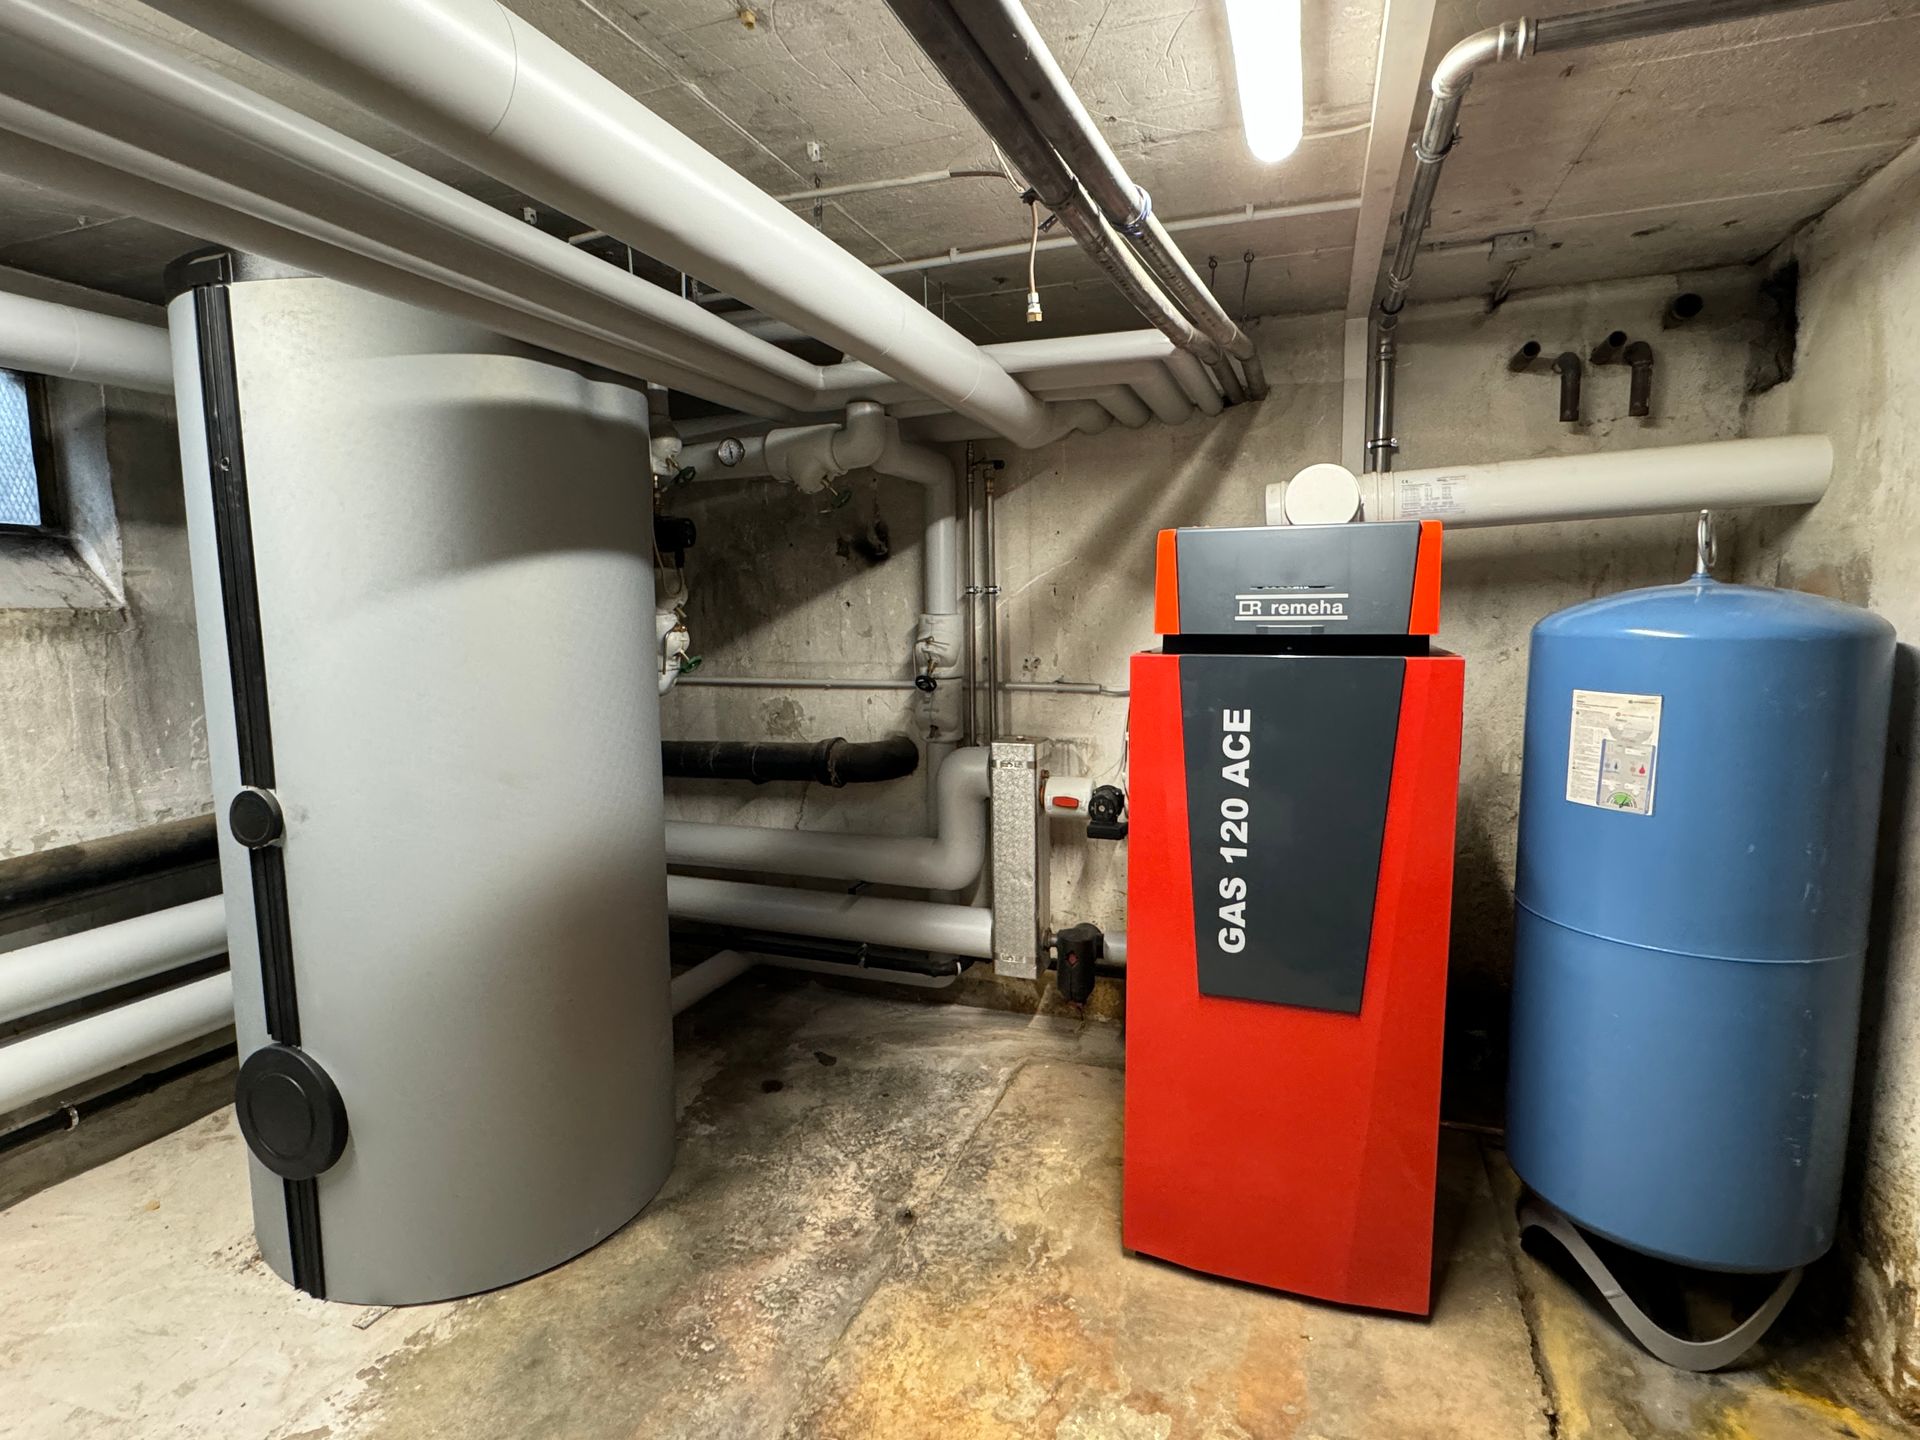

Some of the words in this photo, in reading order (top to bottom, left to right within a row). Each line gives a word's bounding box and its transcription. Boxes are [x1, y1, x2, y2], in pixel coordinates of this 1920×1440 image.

[1271, 600, 1343, 615] remeha
[1222, 709, 1251, 788] ACE
[1219, 798, 1249, 863] 120
[1218, 877, 1247, 954] GAS
